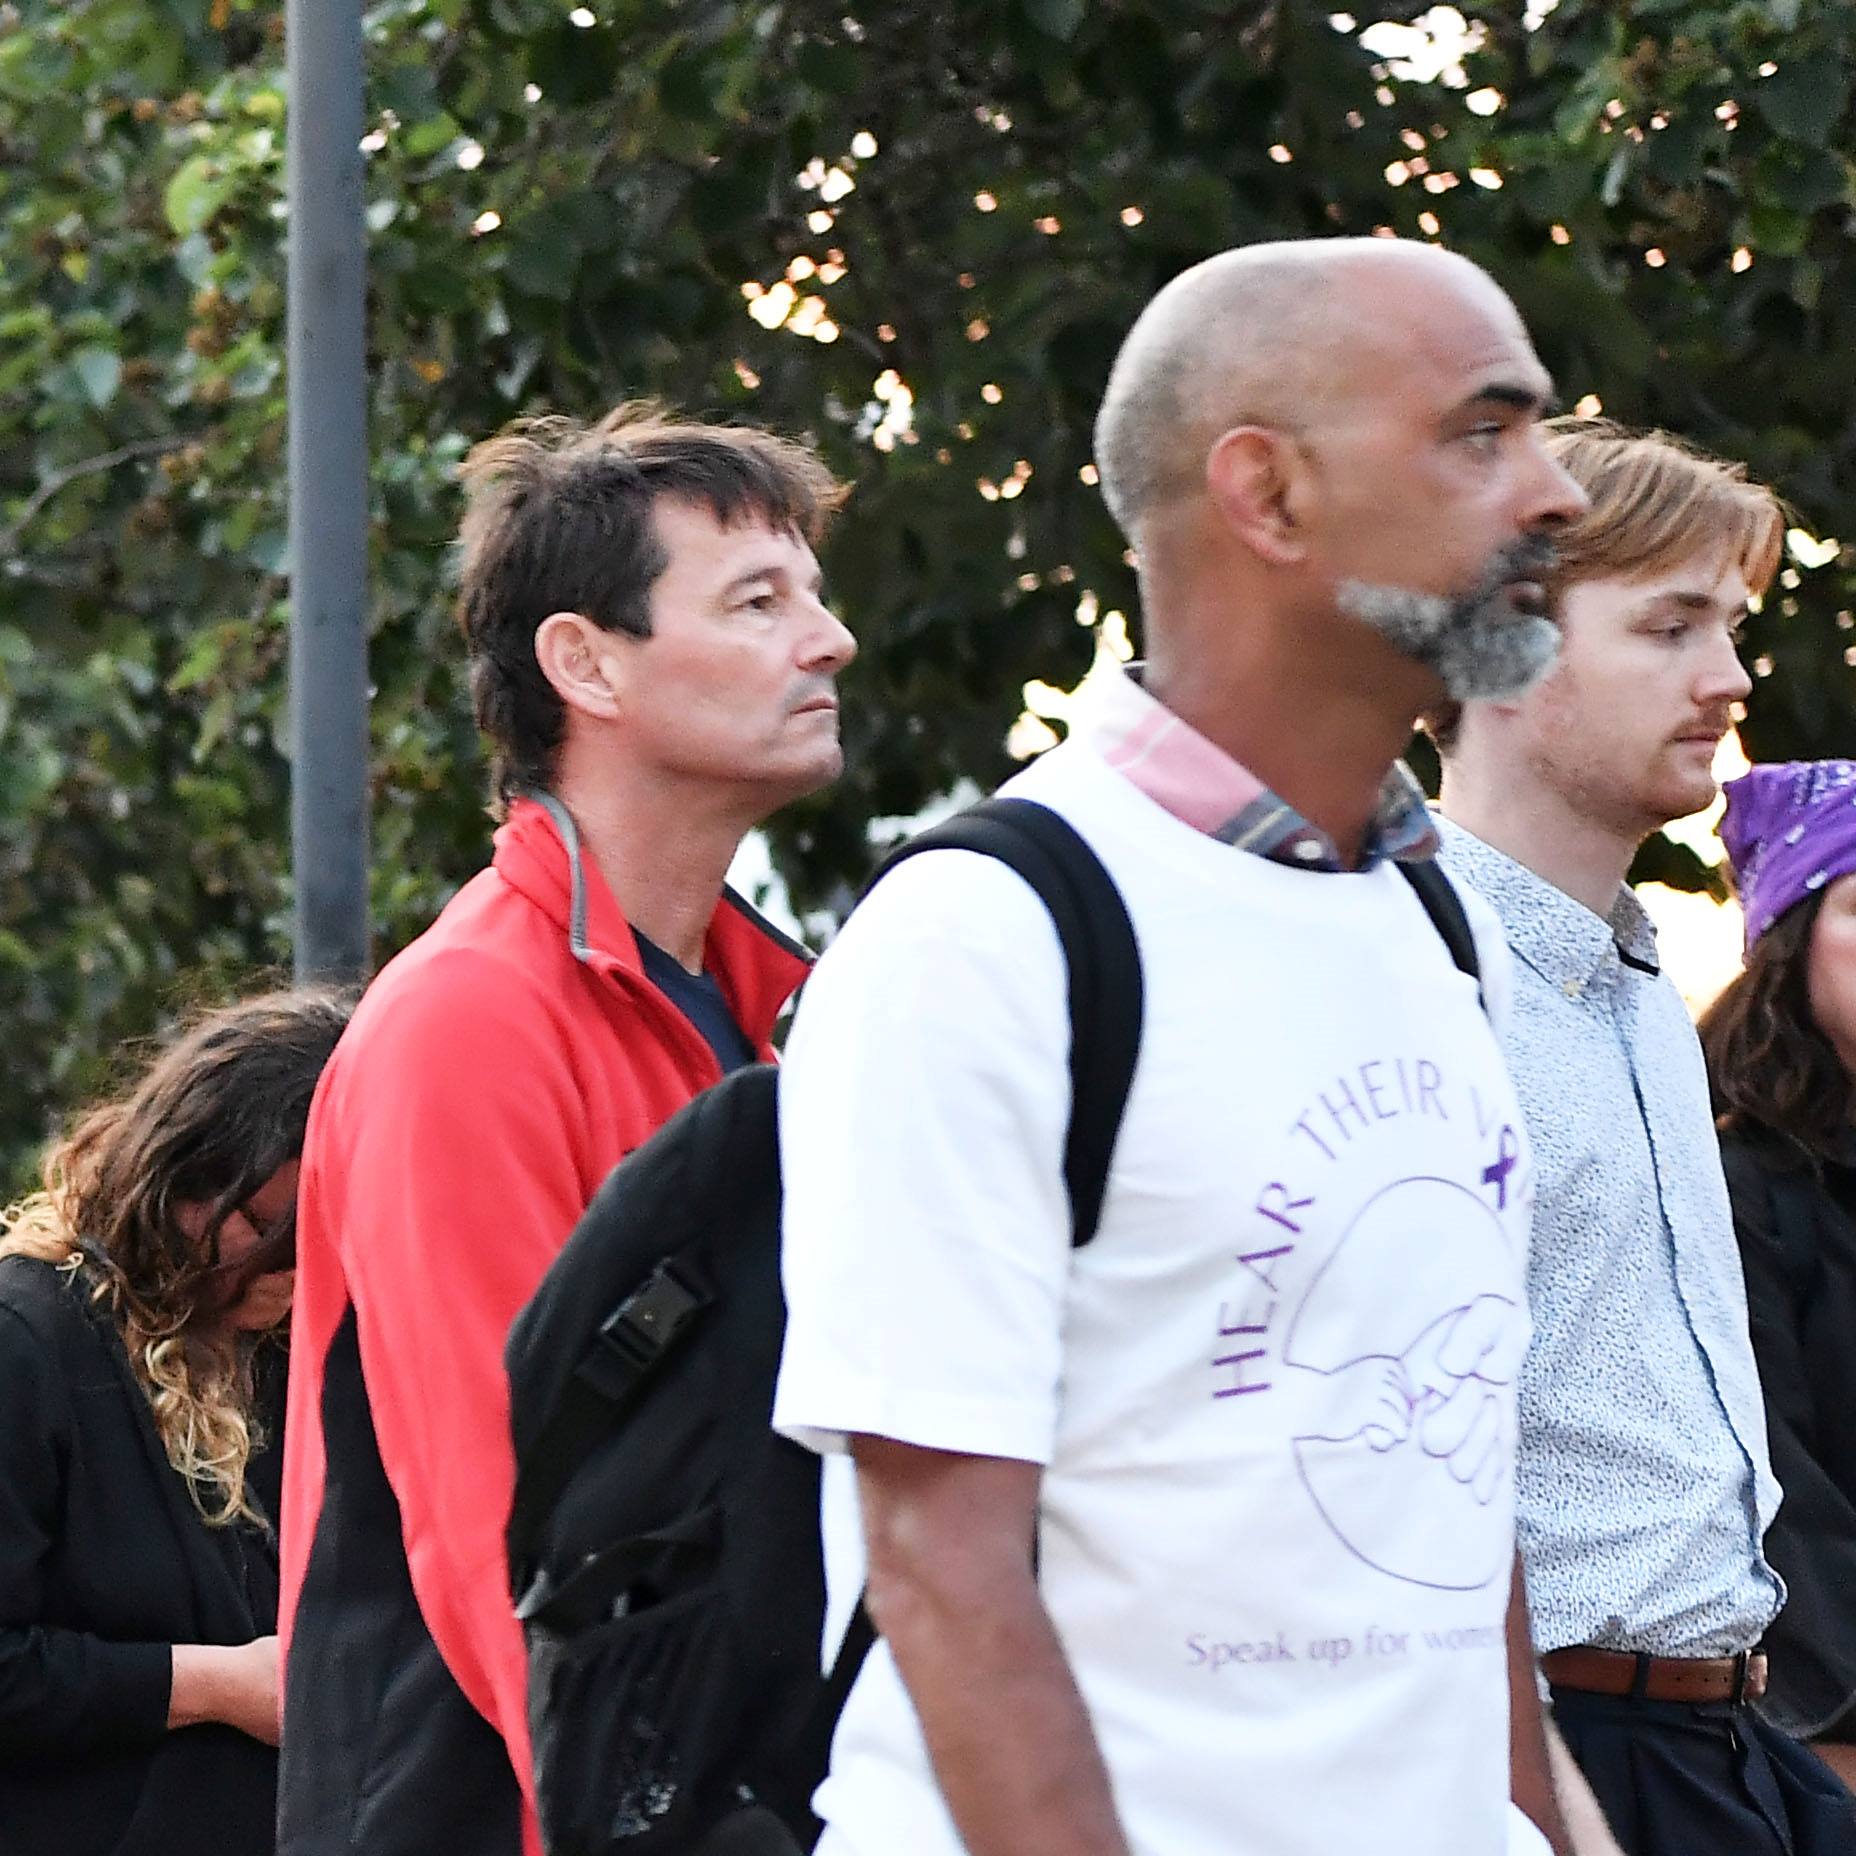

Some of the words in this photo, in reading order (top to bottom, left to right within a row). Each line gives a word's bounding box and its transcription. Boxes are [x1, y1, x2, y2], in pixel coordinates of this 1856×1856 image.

[1212, 1181, 1316, 1400] HEAR
[1289, 1057, 1449, 1161] THEIR
[1186, 1630, 1296, 1672] Speak
[1306, 1637, 1354, 1667] up
[1364, 1624, 1411, 1656] for
